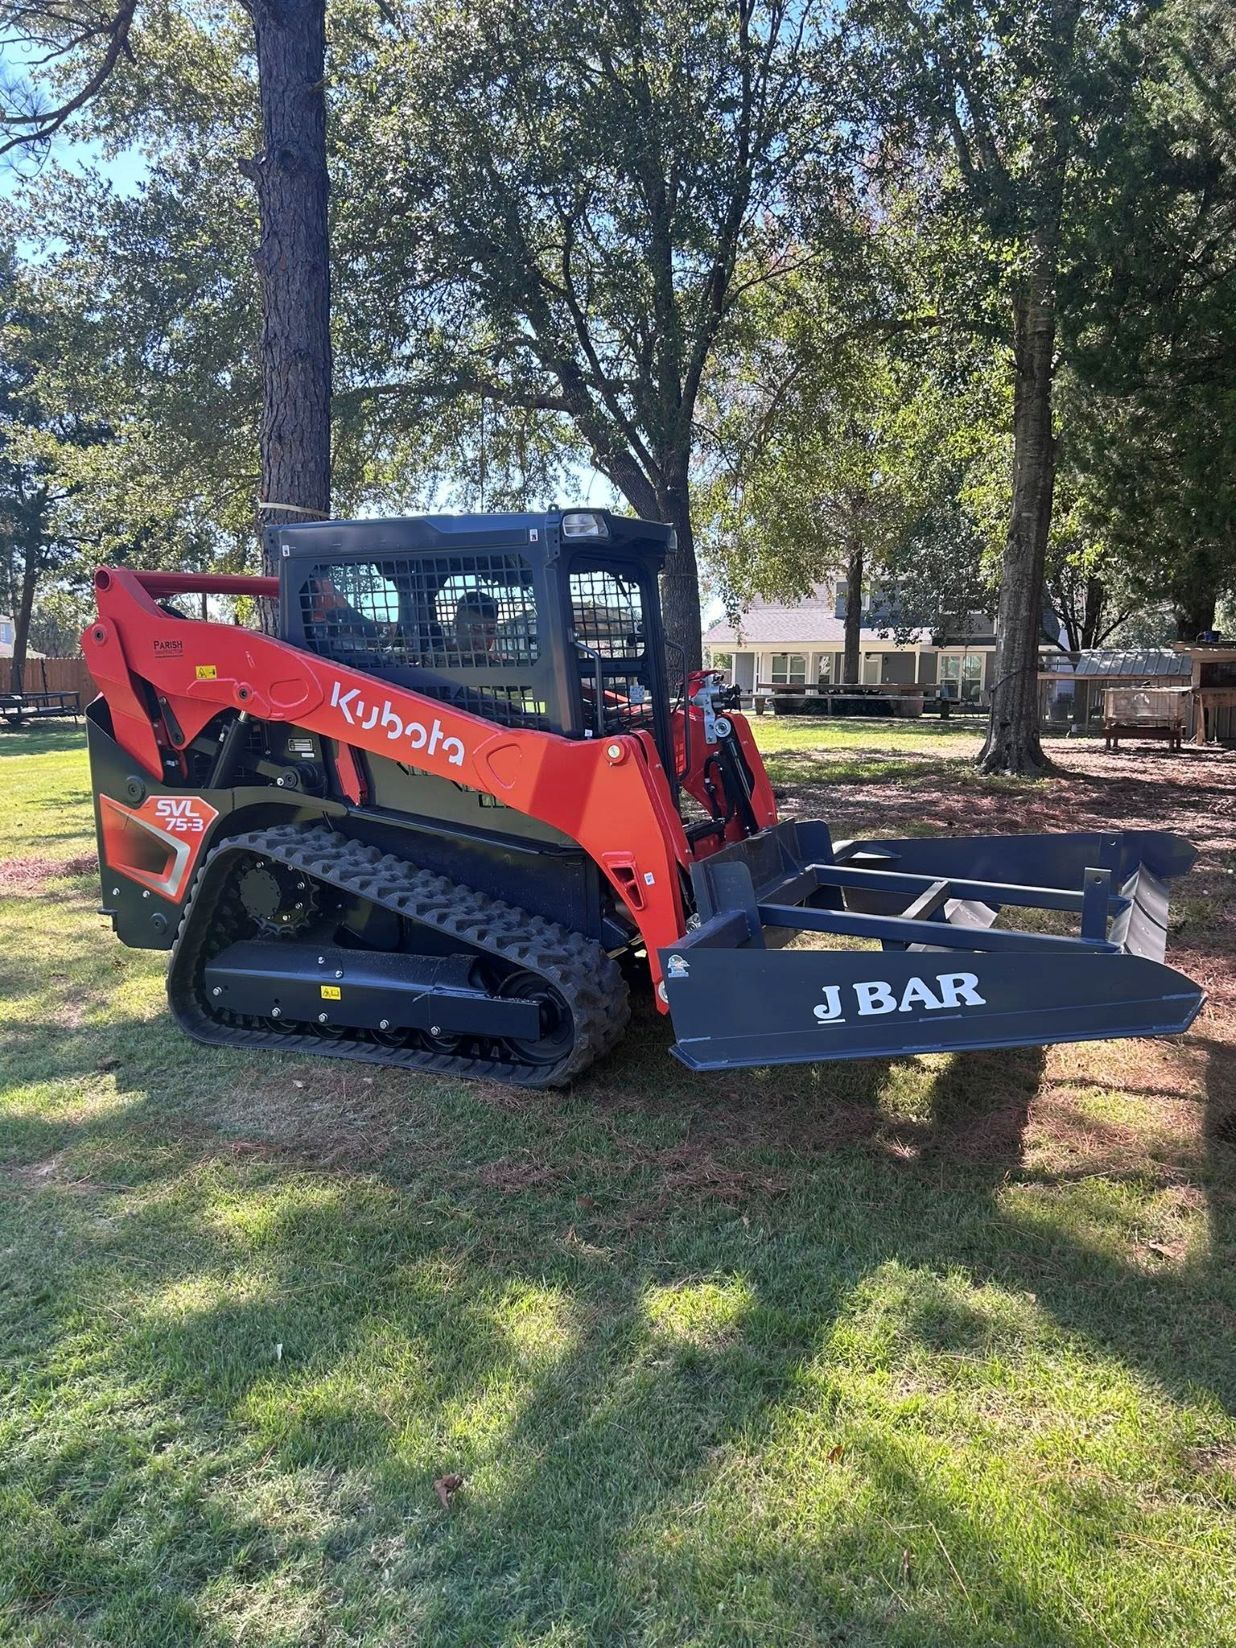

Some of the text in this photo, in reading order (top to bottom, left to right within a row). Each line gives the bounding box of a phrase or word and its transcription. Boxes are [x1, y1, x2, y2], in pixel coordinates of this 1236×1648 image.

[330, 681, 465, 767] Kubota
[155, 799, 200, 817] SVL
[165, 817, 204, 832] 75-3
[813, 972, 987, 1023] J BAR
